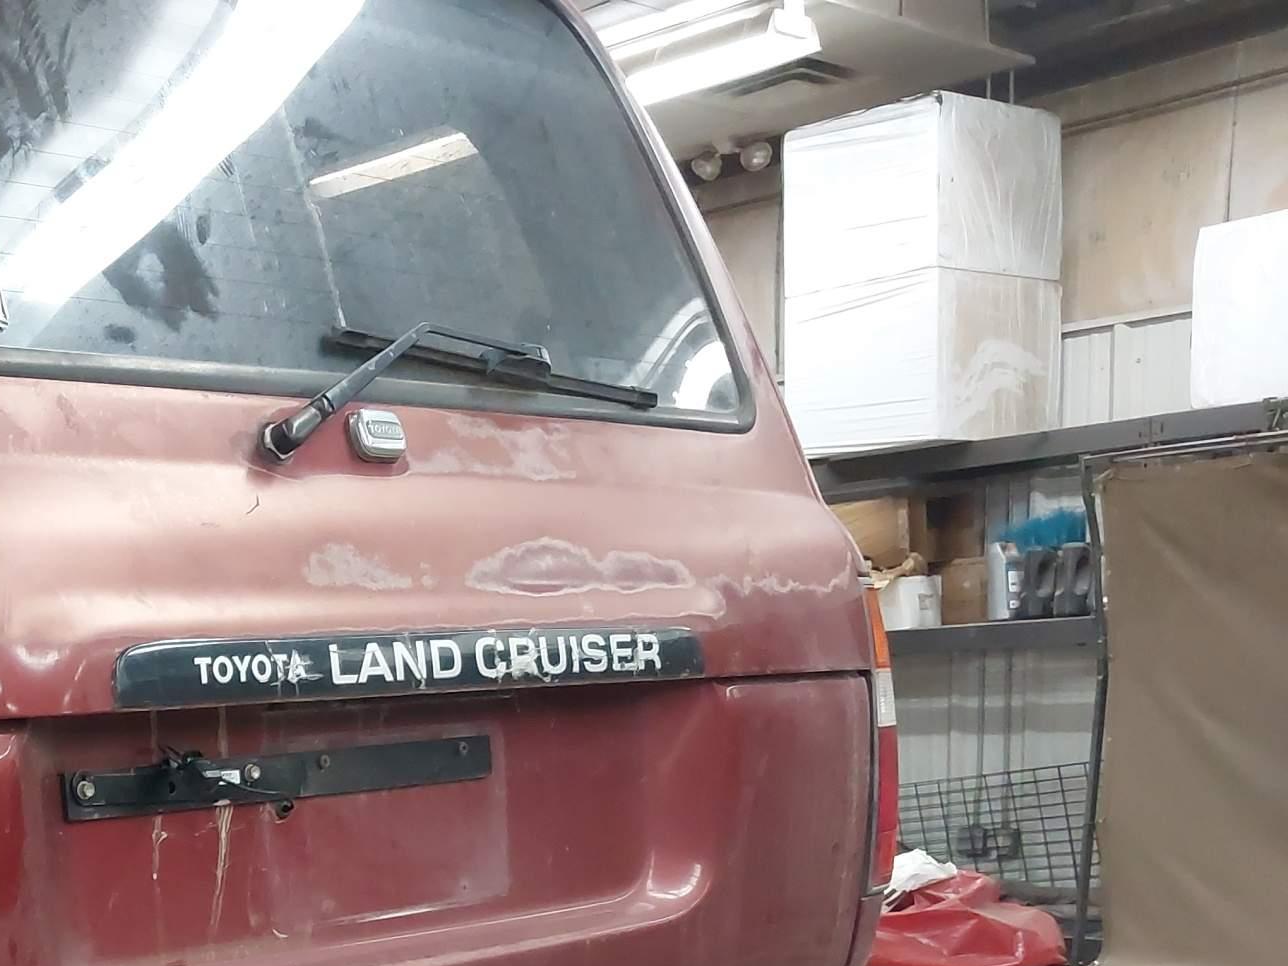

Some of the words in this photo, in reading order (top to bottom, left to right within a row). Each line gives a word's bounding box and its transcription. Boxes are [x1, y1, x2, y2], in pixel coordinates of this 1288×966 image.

[194, 649, 308, 684] TOYOTA
[329, 639, 462, 684] LAND
[475, 632, 661, 679] CRUISER
